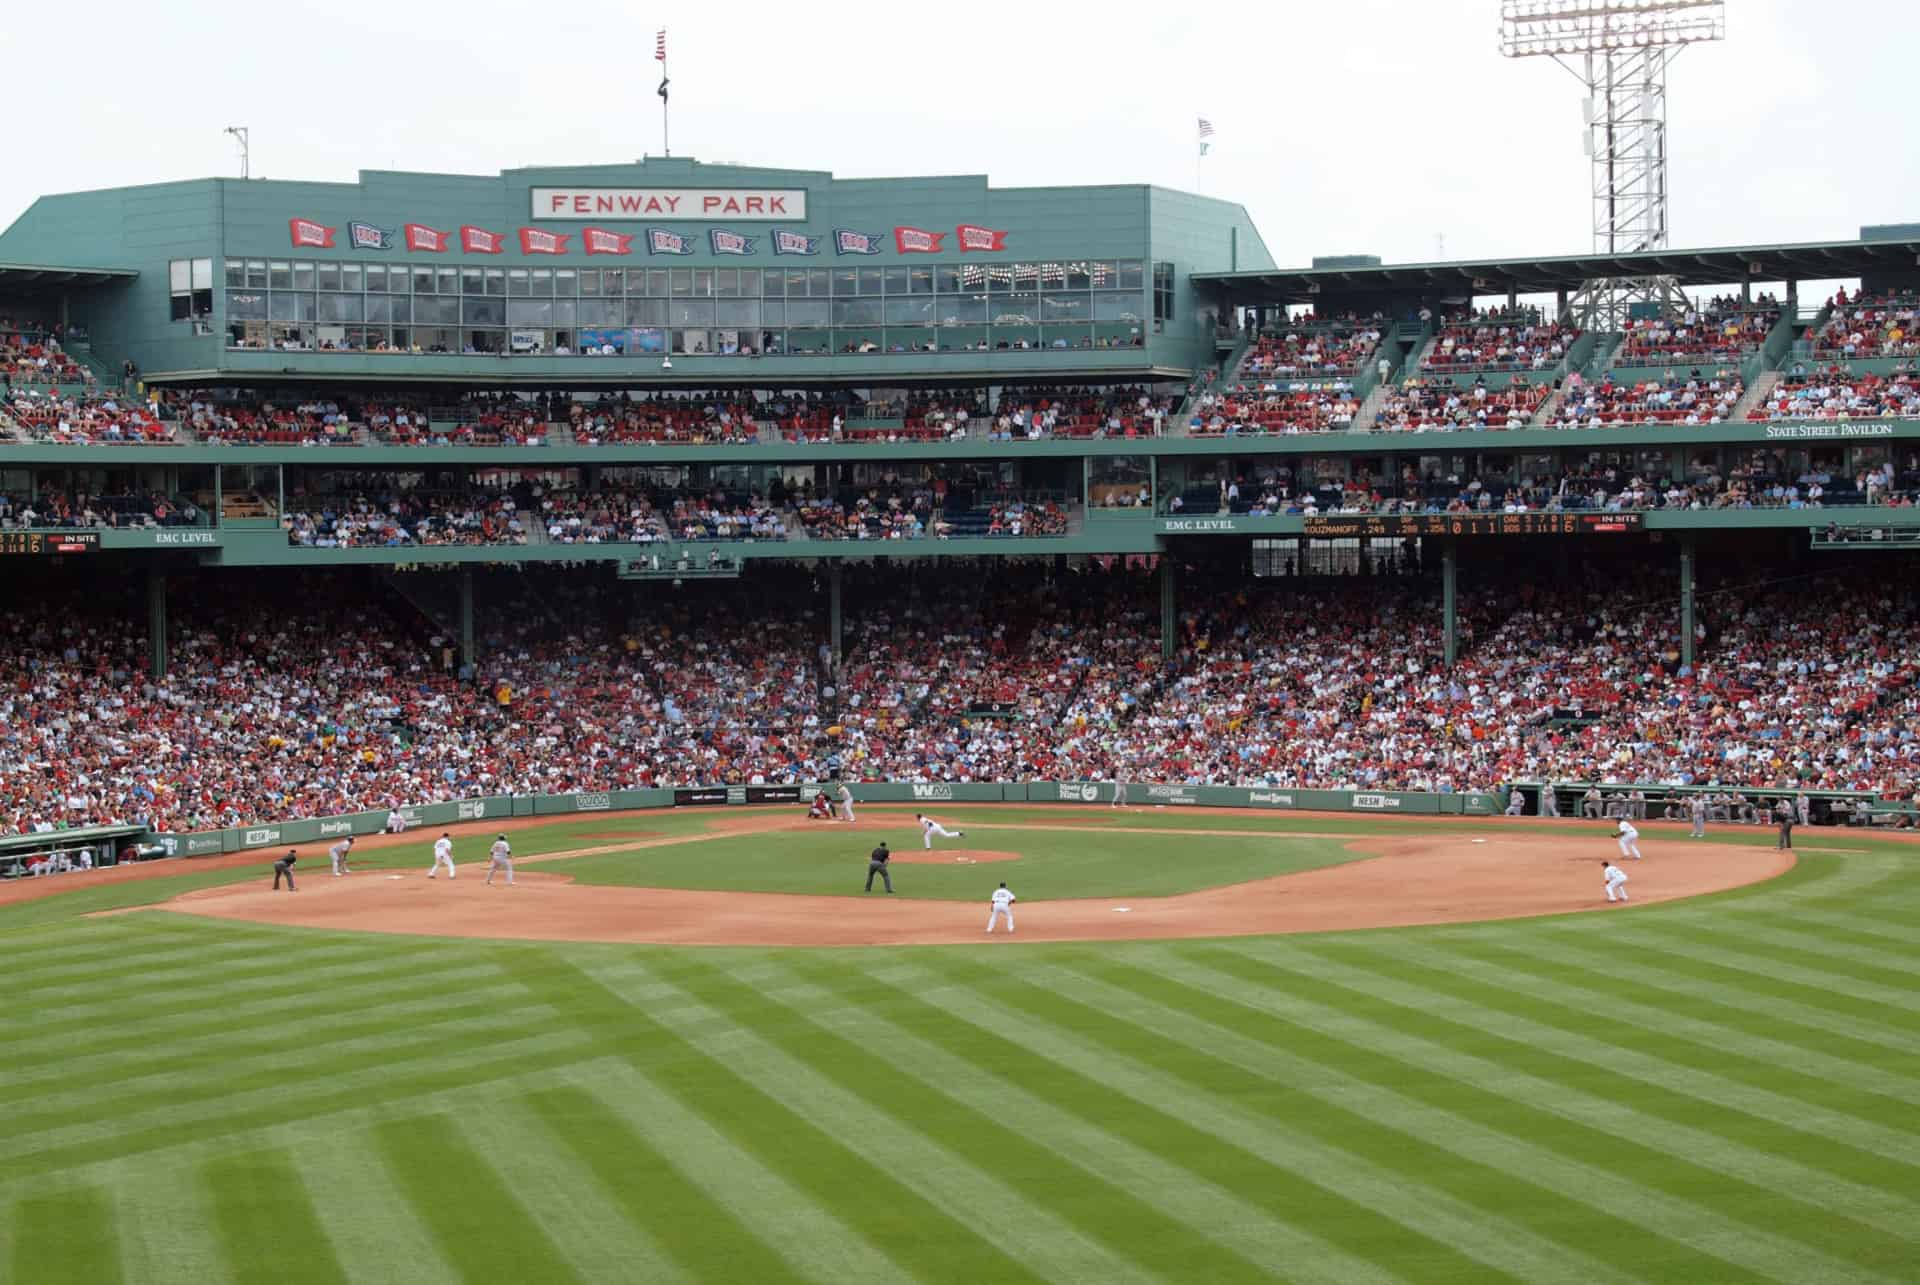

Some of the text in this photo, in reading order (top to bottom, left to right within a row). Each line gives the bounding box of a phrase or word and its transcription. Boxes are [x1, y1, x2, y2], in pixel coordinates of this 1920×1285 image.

[552, 195, 787, 214] FENWAY PARK
[1766, 423, 1892, 437] STATE STREET PAVILION
[1602, 515, 1613, 523] IN
[1615, 515, 1639, 523] SITE
[1166, 520, 1235, 530] EMC LEVEL
[1472, 521, 1479, 534] 1
[65, 535, 75, 543] IN
[76, 535, 97, 543] SITE
[156, 533, 216, 544] EMC LEVEL
